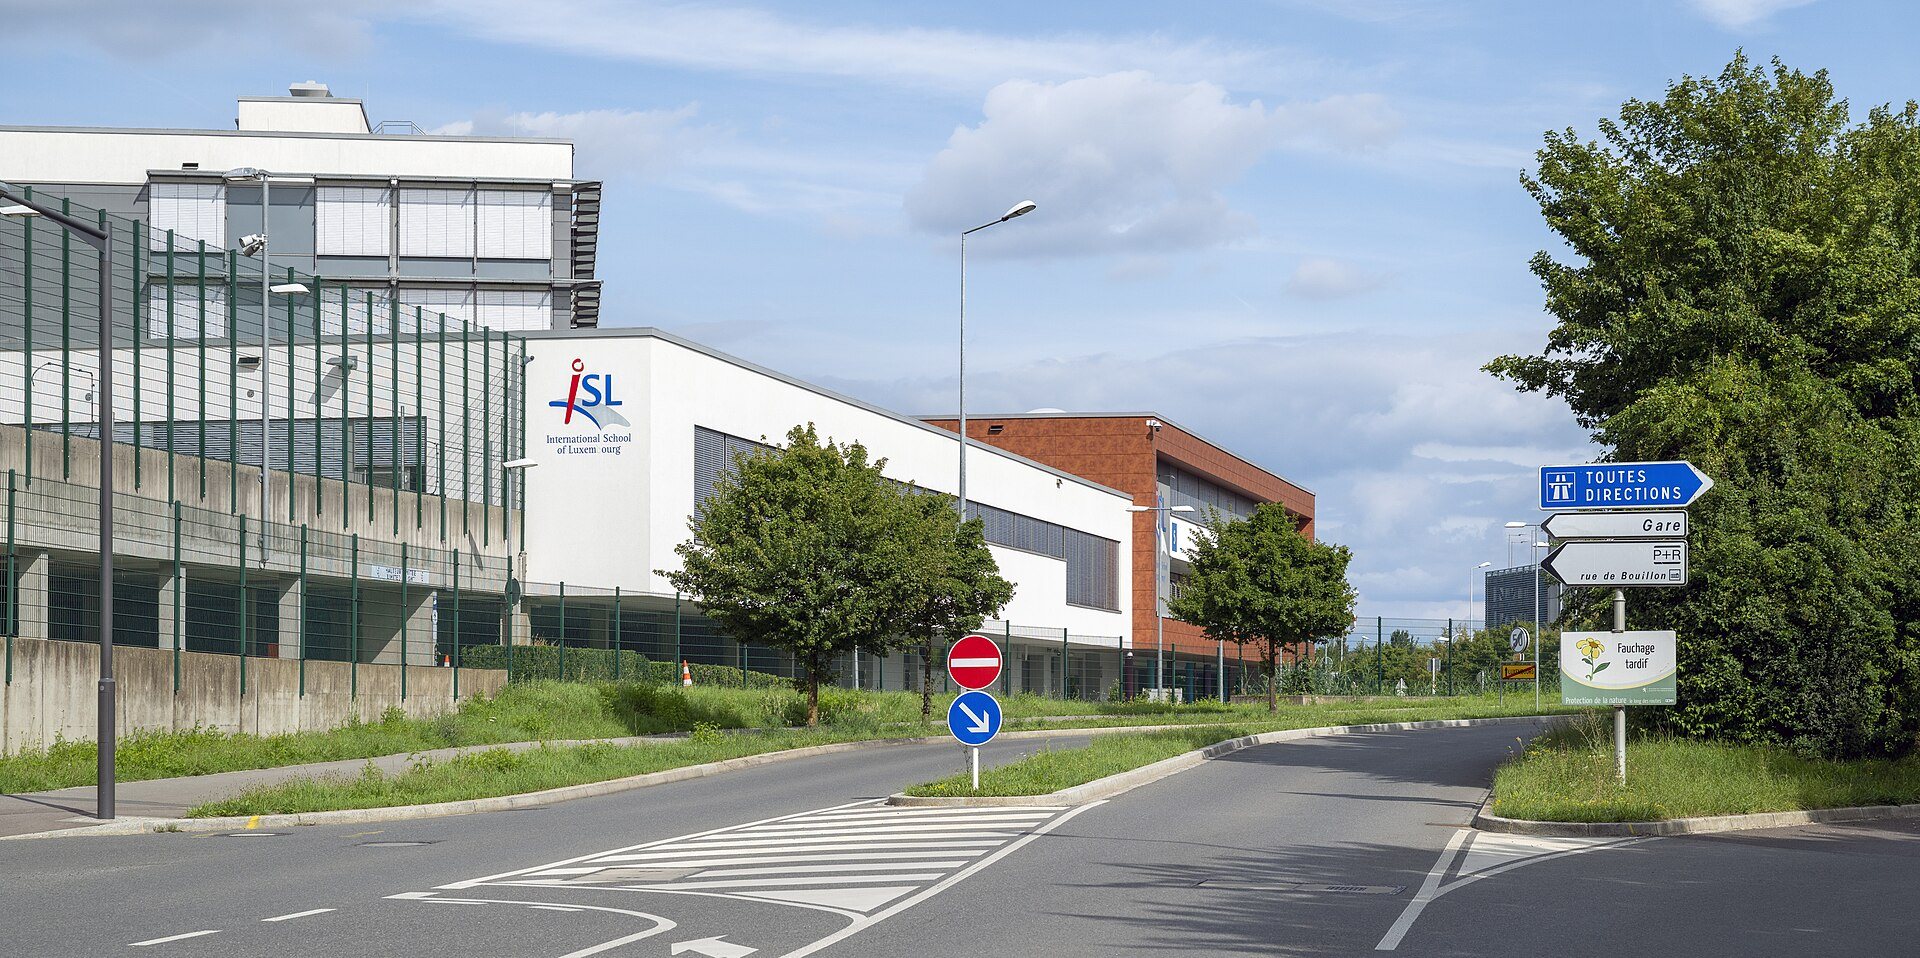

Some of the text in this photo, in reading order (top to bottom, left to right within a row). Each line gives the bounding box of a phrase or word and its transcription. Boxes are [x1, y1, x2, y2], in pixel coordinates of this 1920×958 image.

[546, 433, 631, 444] International School
[557, 445, 621, 456] of Luxemourg
[1585, 470, 1646, 484] TOUTES
[1585, 486, 1681, 502] DIRECTIONS
[1642, 519, 1681, 532] Gare
[1653, 549, 1681, 561] P+R
[1580, 571, 1667, 581] rue de Bouillon
[1512, 632, 1523, 648] 50
[1617, 642, 1656, 655] Fauchage
[1625, 657, 1650, 669] tardif
[1565, 696, 1593, 704] Protection
[1594, 696, 1601, 704] de
[1602, 696, 1608, 704] la
[1609, 696, 1627, 704] nature
